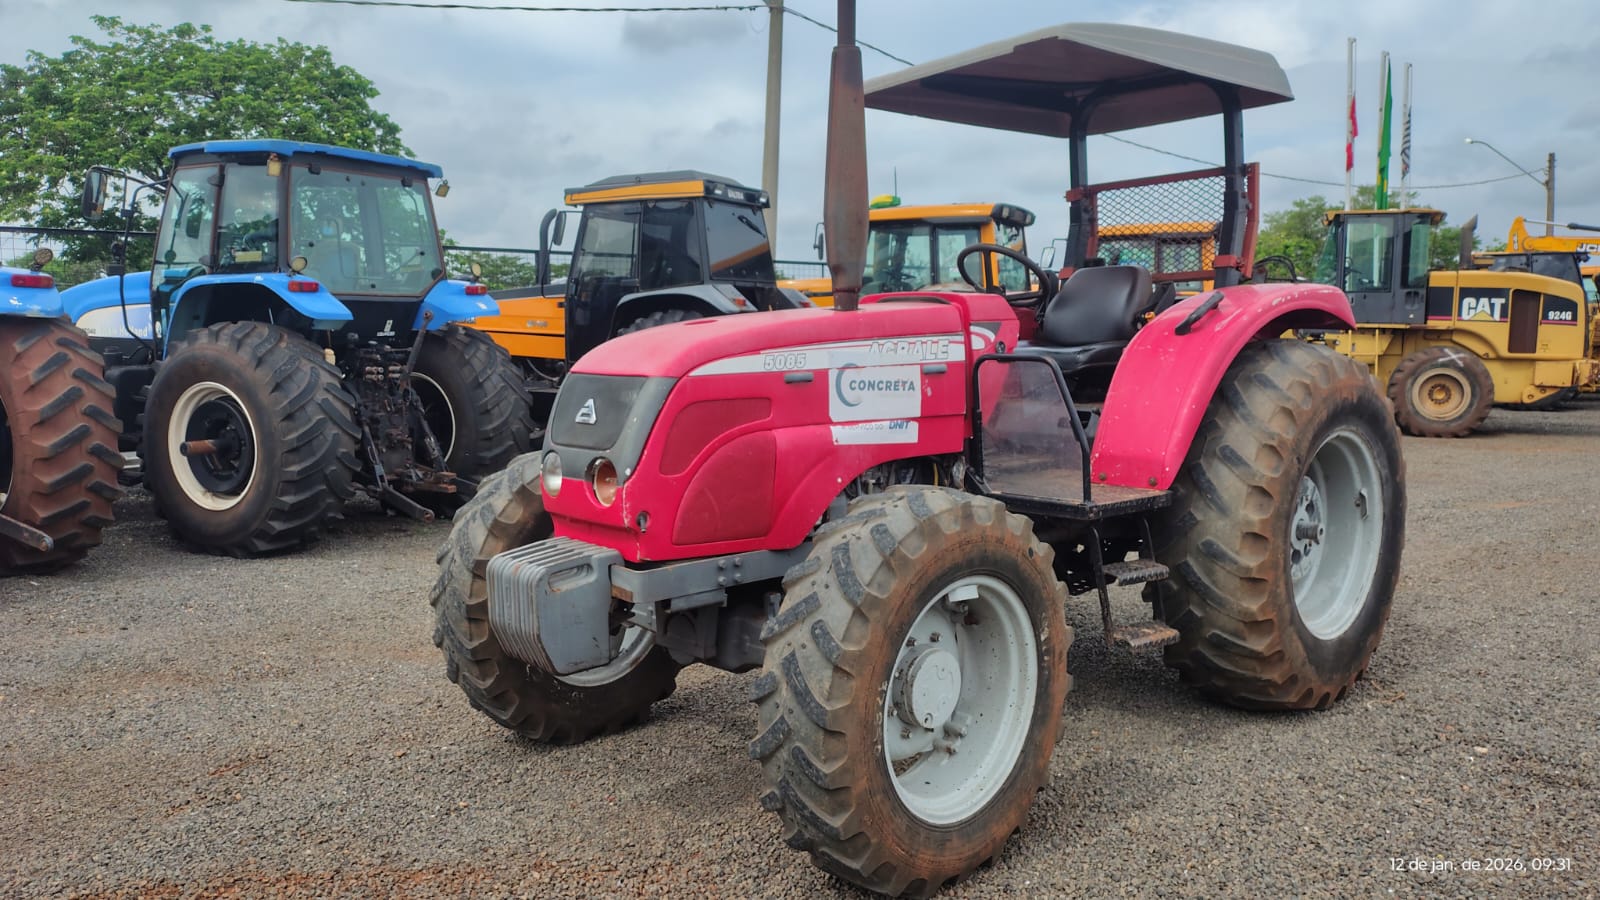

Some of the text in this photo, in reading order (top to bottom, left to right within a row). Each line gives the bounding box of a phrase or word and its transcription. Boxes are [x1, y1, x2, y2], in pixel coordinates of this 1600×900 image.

[1577, 242, 1600, 252] JC
[1462, 297, 1506, 320] CAT
[1548, 311, 1572, 320] 924G
[849, 379, 916, 392] CONCRETA
[889, 420, 911, 430] DNIT
